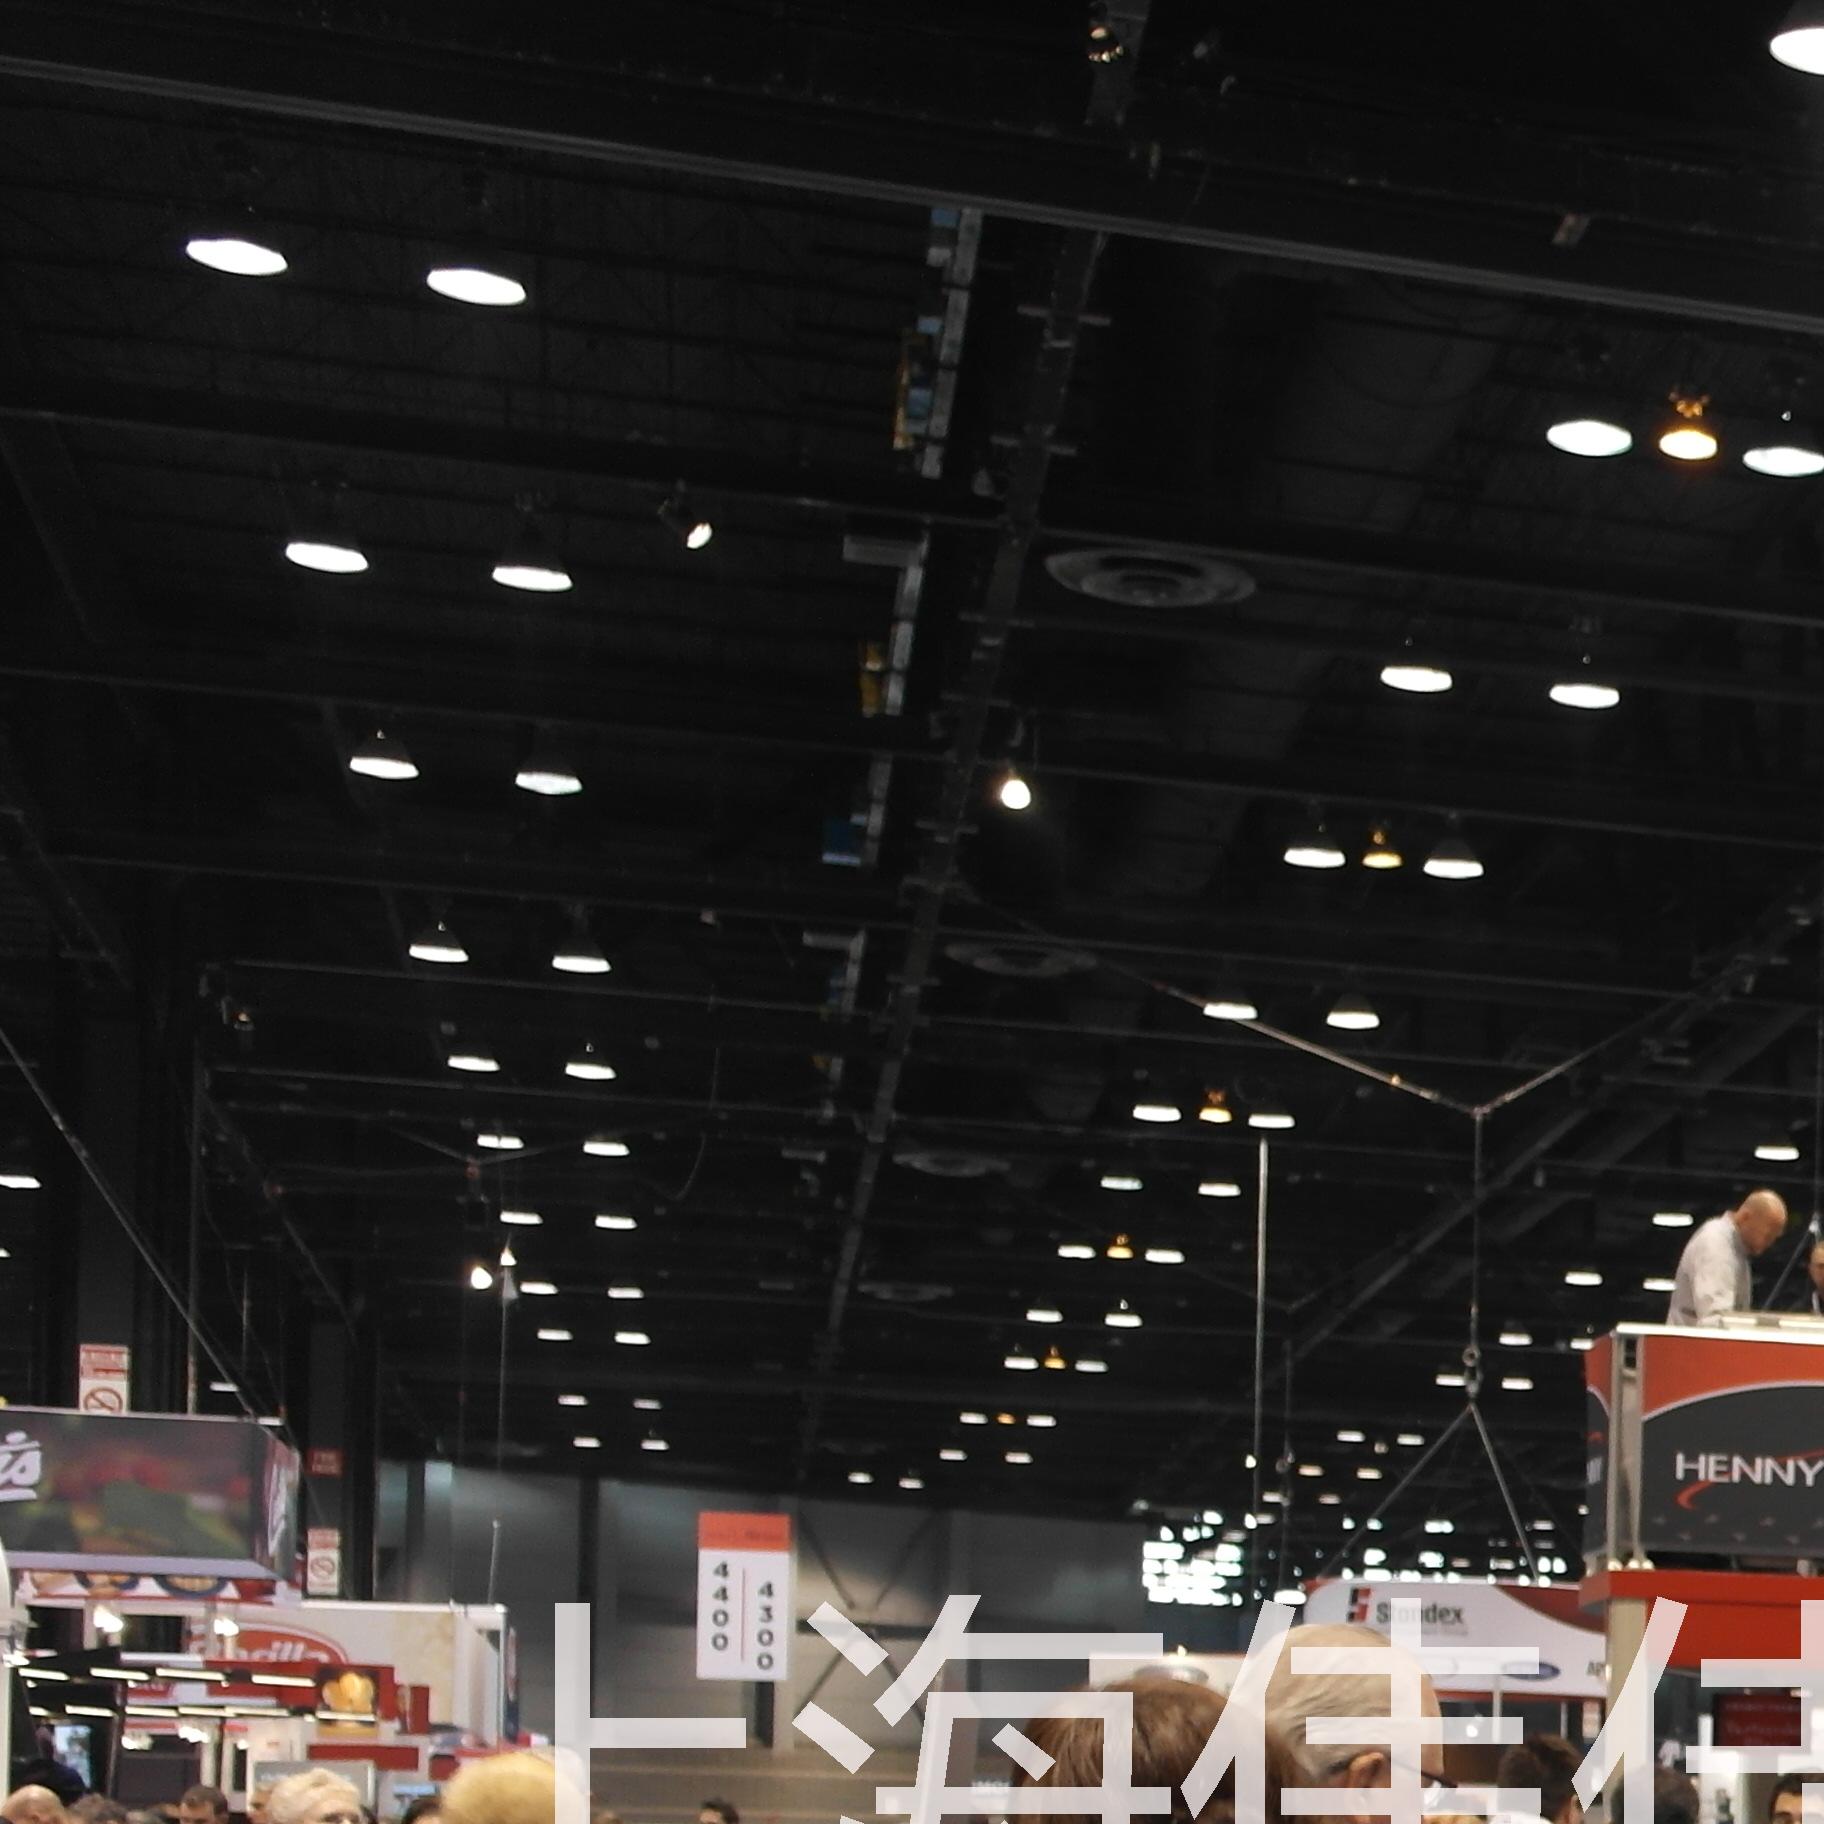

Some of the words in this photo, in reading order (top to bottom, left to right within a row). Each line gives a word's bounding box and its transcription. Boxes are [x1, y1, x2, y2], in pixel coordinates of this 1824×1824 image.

[1674, 1451, 1824, 1490] HENNY
[711, 1560, 729, 1651] 4400
[756, 1582, 775, 1671] 4300
